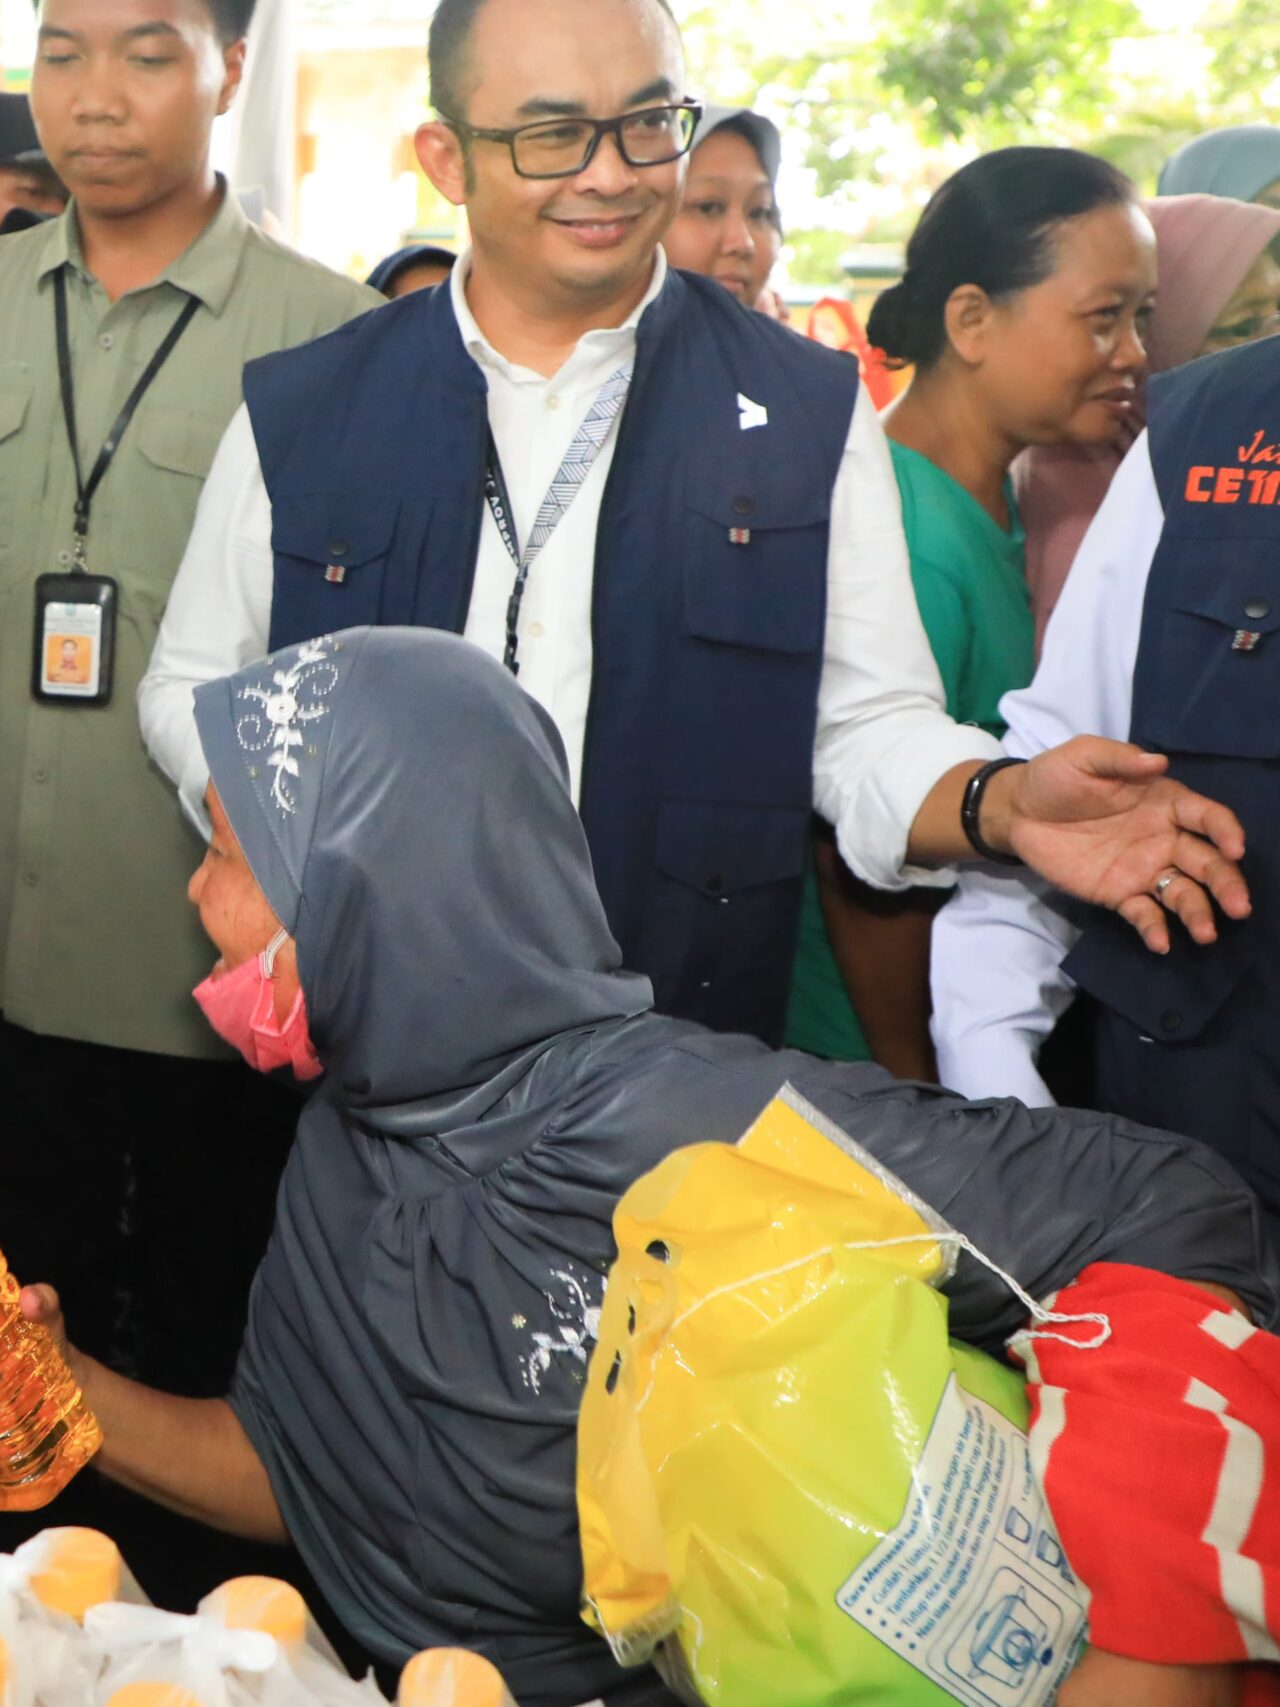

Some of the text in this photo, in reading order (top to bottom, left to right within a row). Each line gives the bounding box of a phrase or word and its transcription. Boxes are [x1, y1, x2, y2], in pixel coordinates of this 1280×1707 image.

[1238, 429, 1280, 465] Ja
[1184, 465, 1280, 505] CETT
[872, 1570, 903, 1604] Cucilah
[905, 1541, 932, 1567] (satu)
[931, 1493, 948, 1520] beras
[942, 1454, 961, 1493] dengan
[902, 1600, 928, 1627] Tutup
[925, 1583, 941, 1600] rice
[940, 1549, 961, 1584] cooker
[956, 1529, 969, 1550] dan
[964, 1496, 979, 1528] masak
[916, 1617, 936, 1638] Nasi
[948, 1556, 975, 1600] disajikan
[970, 1536, 981, 1557] dan
[978, 1514, 991, 1536] siap
[986, 1484, 999, 1513] untuk
[844, 1584, 866, 1607] Cara
[863, 1539, 905, 1584] Memasak
[887, 1566, 933, 1615] Tambahkan
[935, 1540, 949, 1557] 1/2
